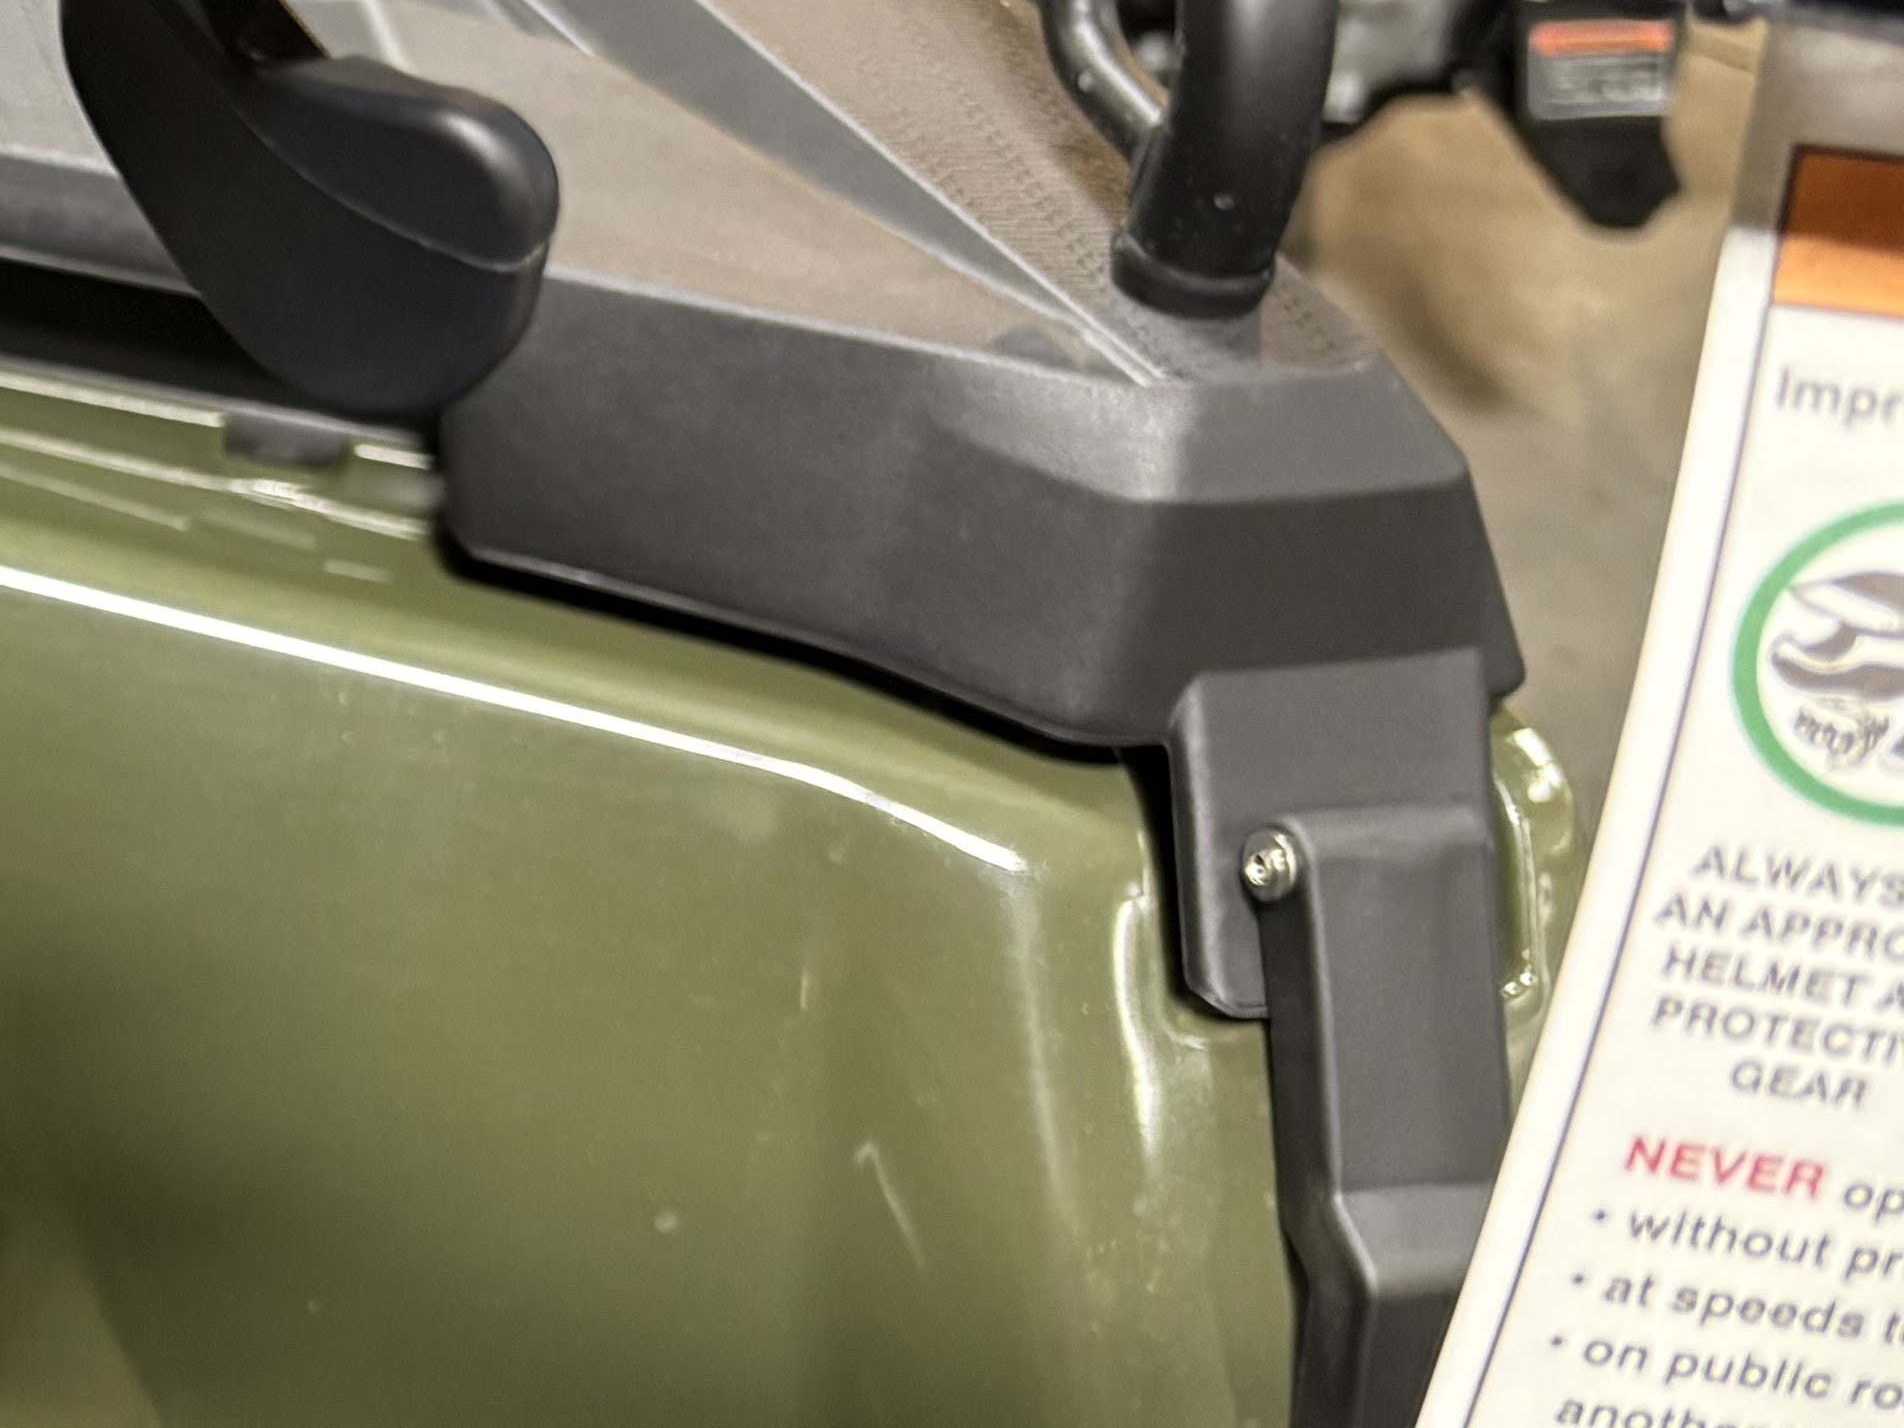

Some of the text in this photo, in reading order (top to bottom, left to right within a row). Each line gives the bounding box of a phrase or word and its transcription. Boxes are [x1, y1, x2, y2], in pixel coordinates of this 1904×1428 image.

[1655, 893, 1729, 931] AN
[1662, 944, 1871, 1007] HELMET
[1730, 1059, 1867, 1110] GEAR
[1624, 1136, 1824, 1198] NEVER
[1629, 1209, 1830, 1266] without
[1603, 1275, 1904, 1344] at speeds t
[1584, 1340, 1904, 1410] on public ro
